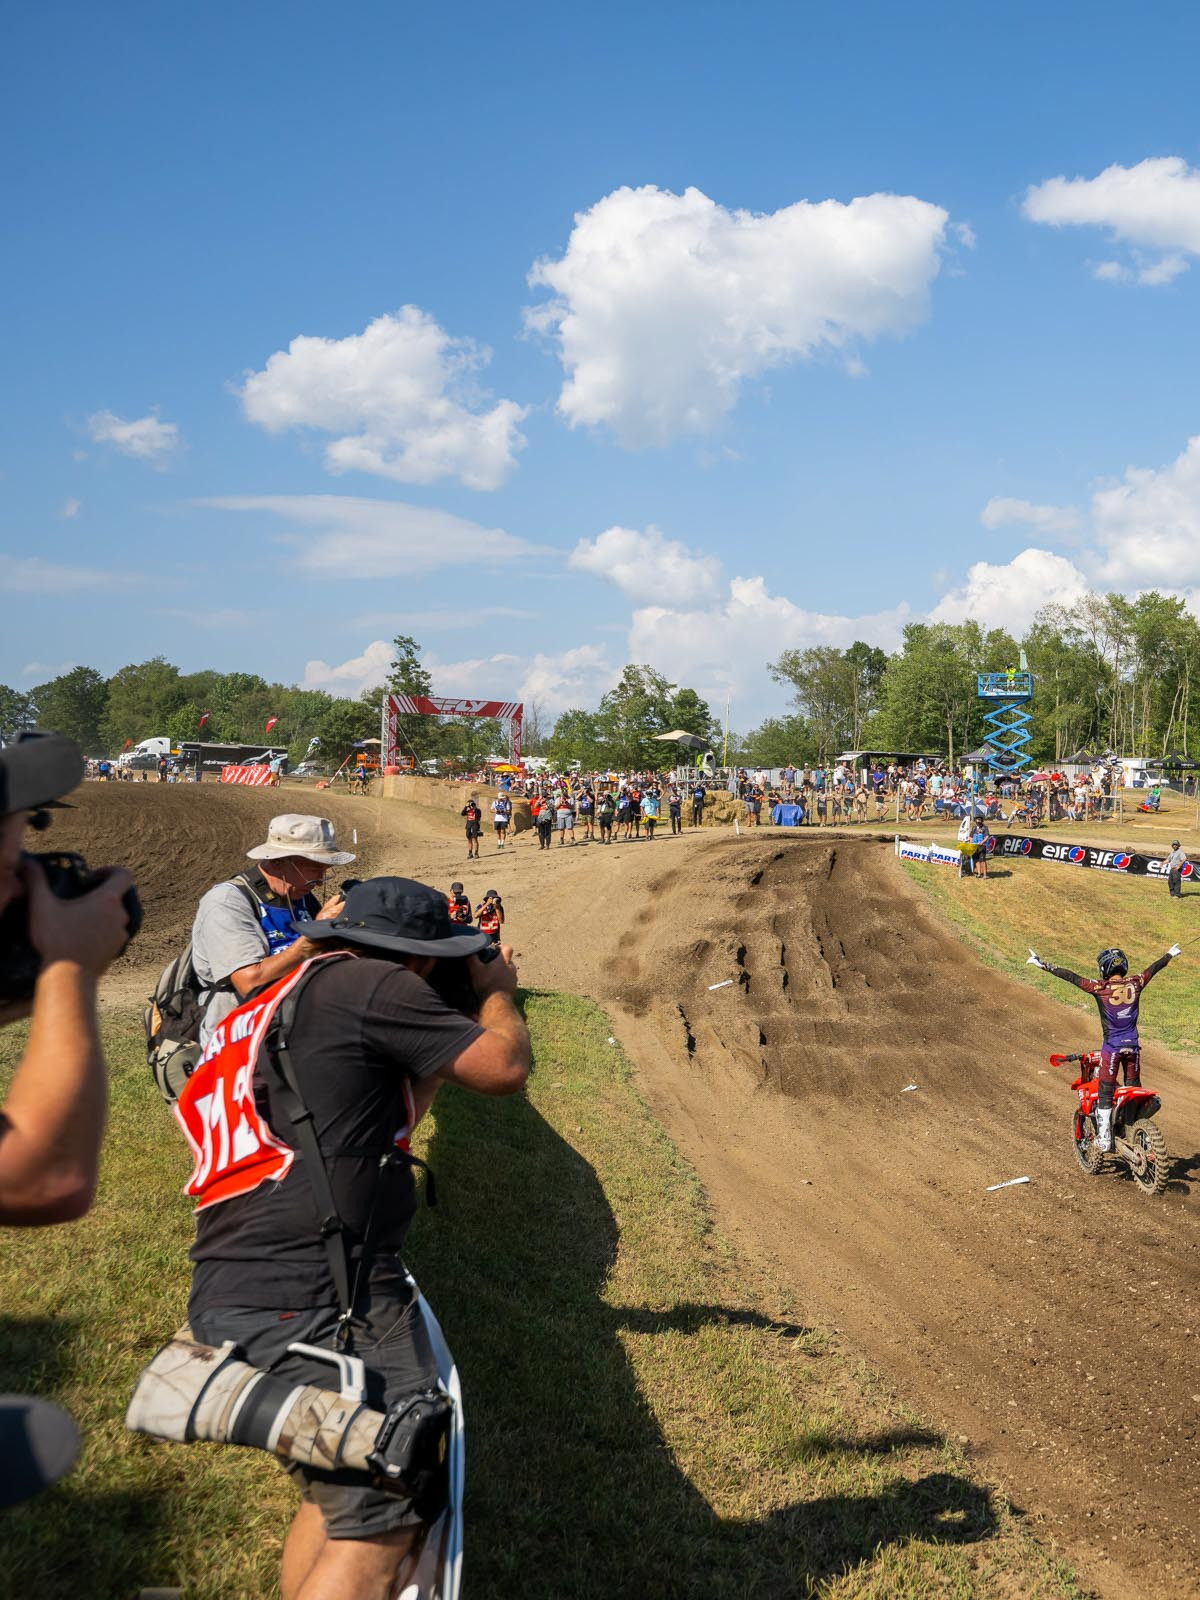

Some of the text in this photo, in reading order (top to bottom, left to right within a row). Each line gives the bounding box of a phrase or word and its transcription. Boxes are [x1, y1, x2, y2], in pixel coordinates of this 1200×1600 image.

[1004, 838, 1022, 853] elf
[1041, 844, 1070, 859] elf
[1109, 983, 1136, 1006] 30
